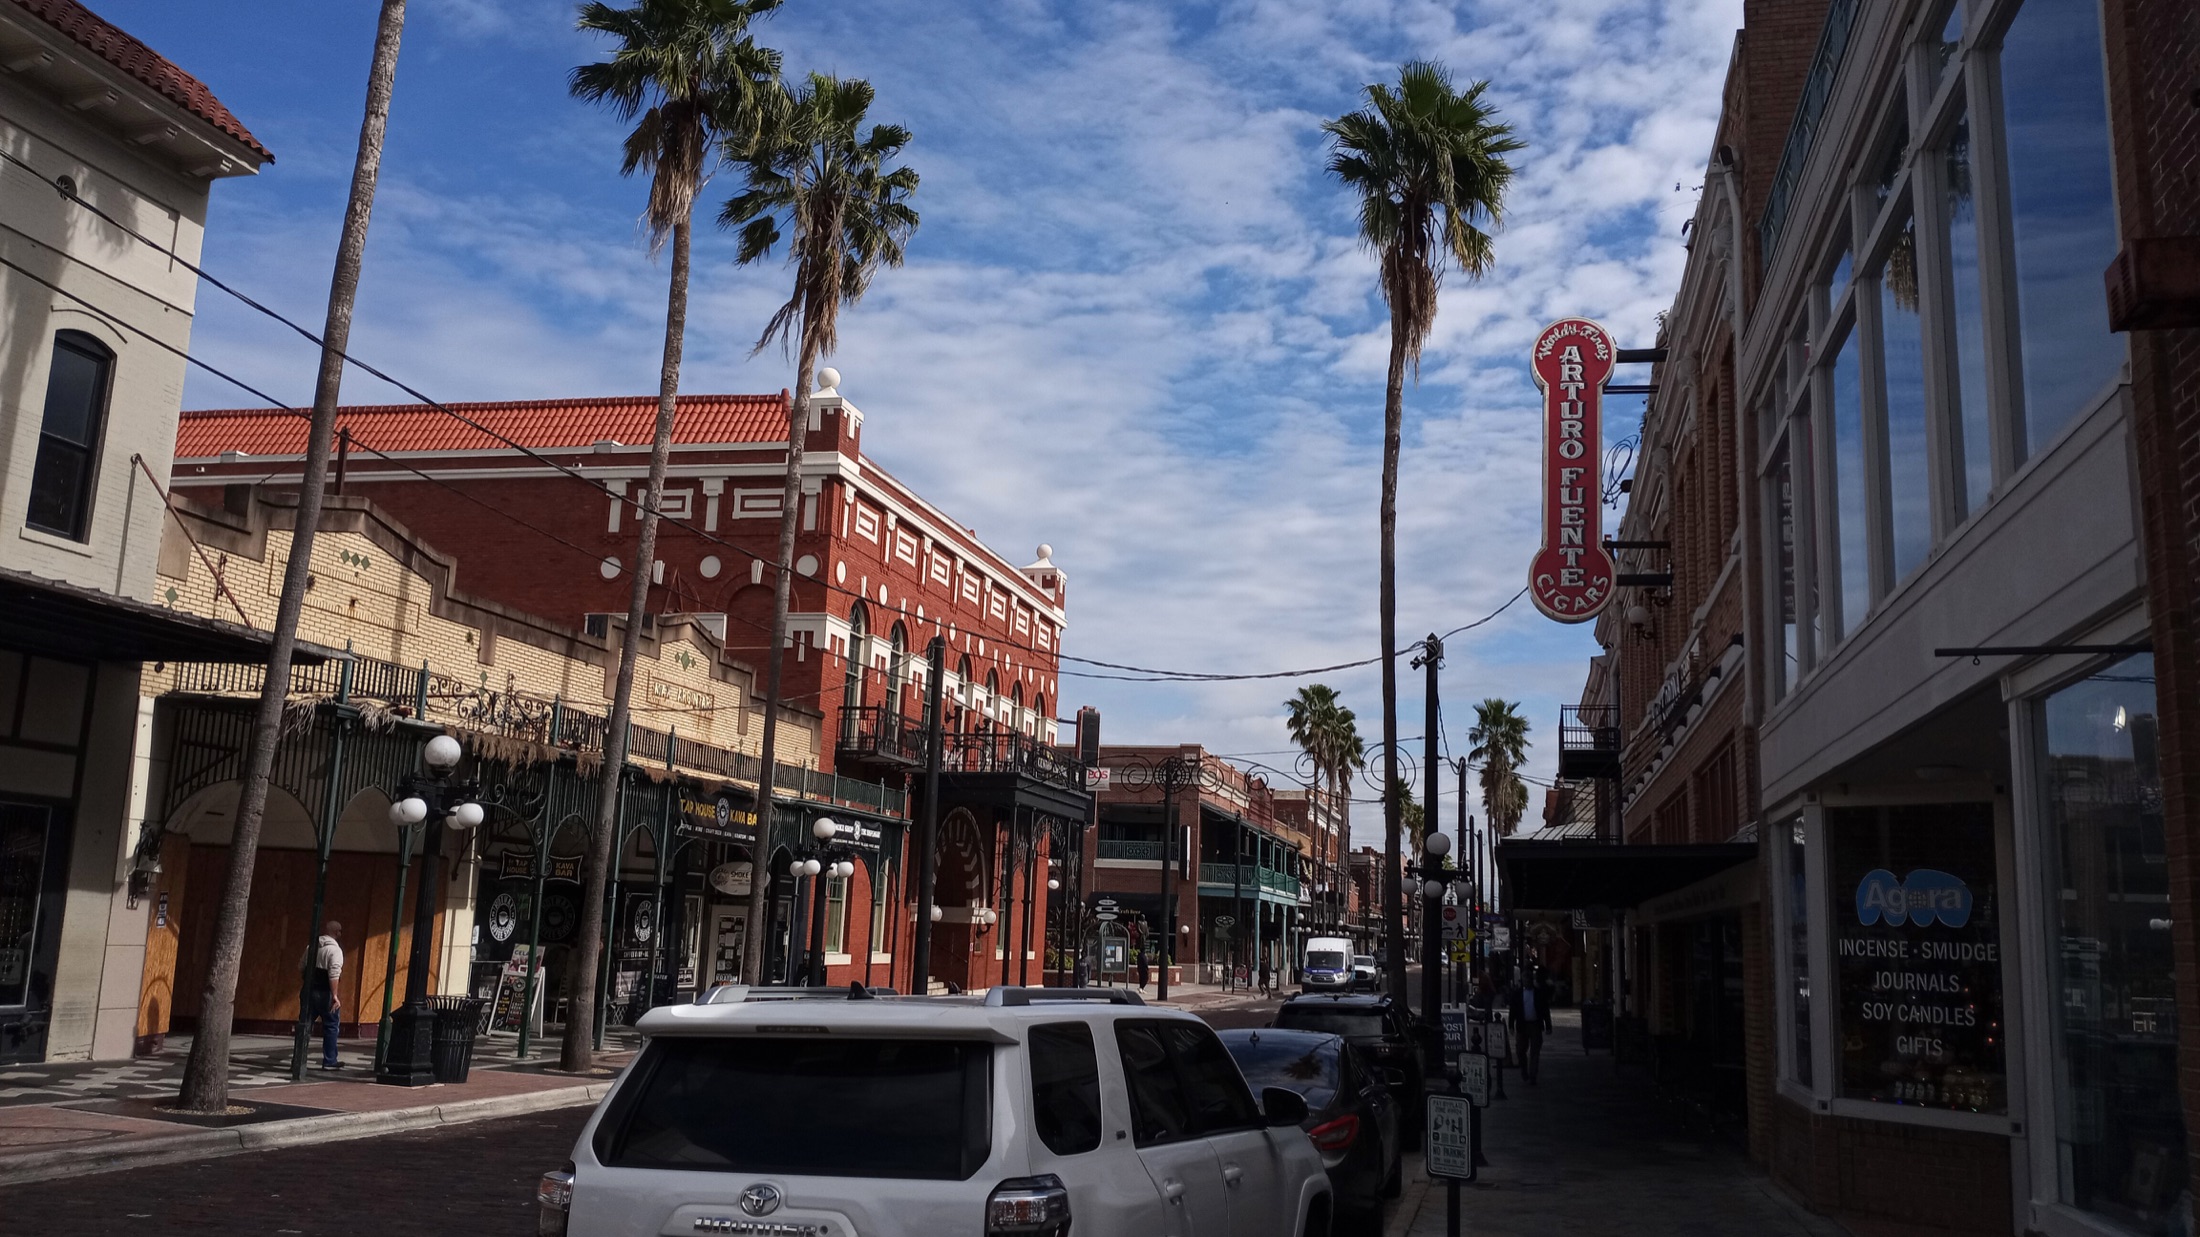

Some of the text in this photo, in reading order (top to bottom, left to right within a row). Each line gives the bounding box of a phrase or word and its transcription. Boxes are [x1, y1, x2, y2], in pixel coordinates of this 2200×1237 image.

[1559, 346, 1585, 587] ARTURO FUENTE
[1537, 574, 1608, 611] CIGARS
[680, 799, 694, 814] TAP
[695, 802, 716, 819] HOUSE
[730, 809, 746, 824] KAVA
[747, 812, 758, 826] BA
[506, 866, 573, 877] HOUSE BAR
[555, 862, 574, 870] KAVA
[730, 871, 749, 879] SMOKE
[1862, 880, 1962, 917] Agora
[1839, 938, 1998, 962] INCENSE SMUDGE
[1872, 971, 1960, 993] JOURNALS
[1862, 1002, 1976, 1027] SOY CANDLES
[1896, 1035, 1944, 1057] GIFTS
[1432, 1145, 1466, 1159] NO PARKING
